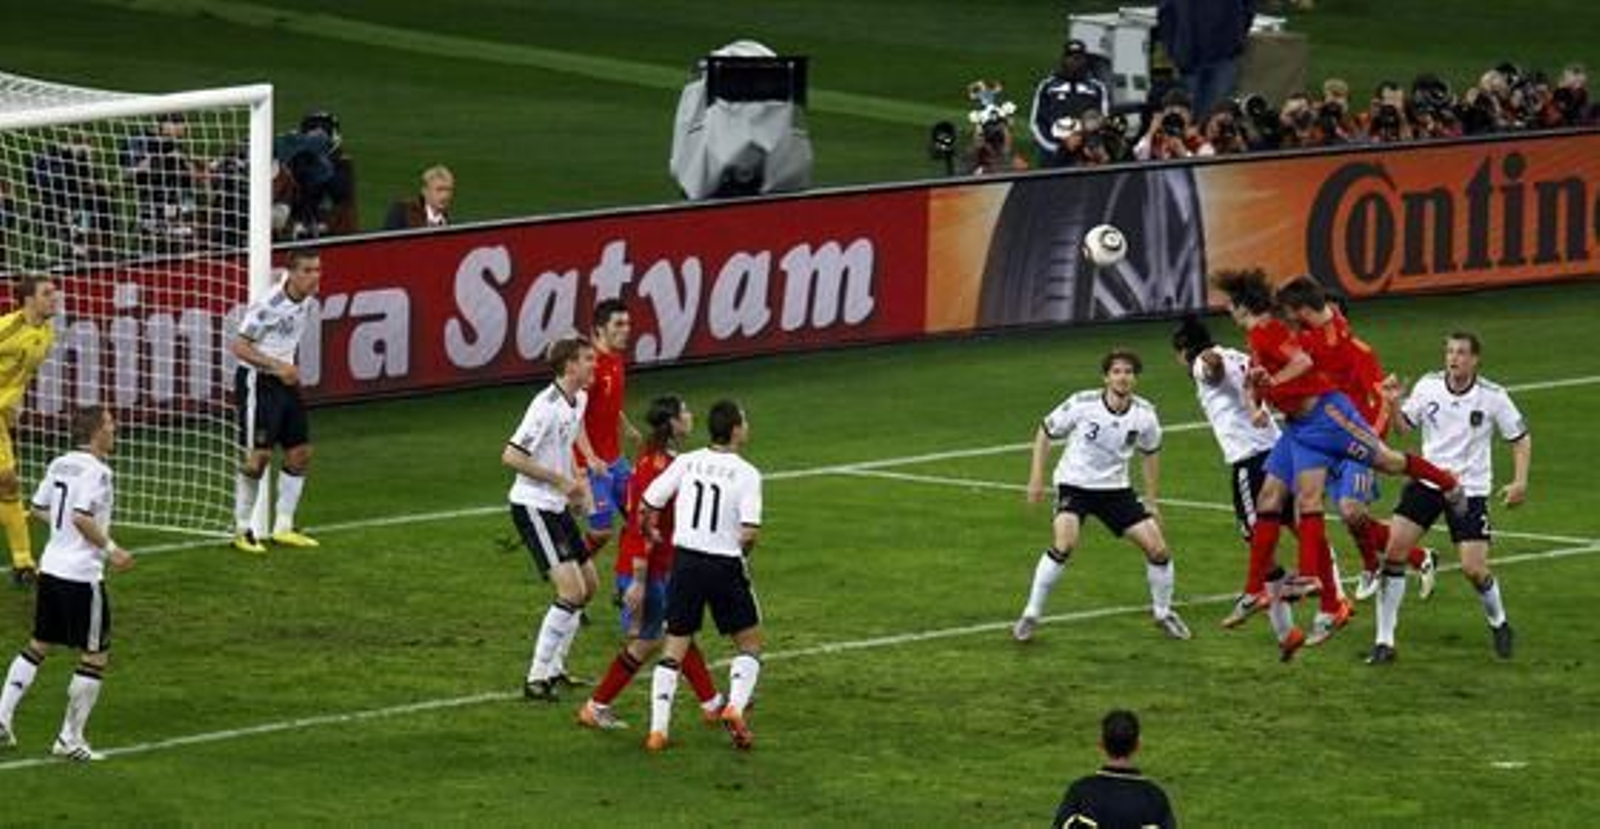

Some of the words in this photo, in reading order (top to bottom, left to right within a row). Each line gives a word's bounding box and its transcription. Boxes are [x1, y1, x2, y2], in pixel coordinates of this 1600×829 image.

[1306, 152, 1600, 298] Contin
[444, 237, 875, 369] Satyam
[1085, 422, 1099, 440] 3
[1427, 401, 1440, 430] 2
[53, 480, 69, 530] 7
[691, 479, 721, 534] 11
